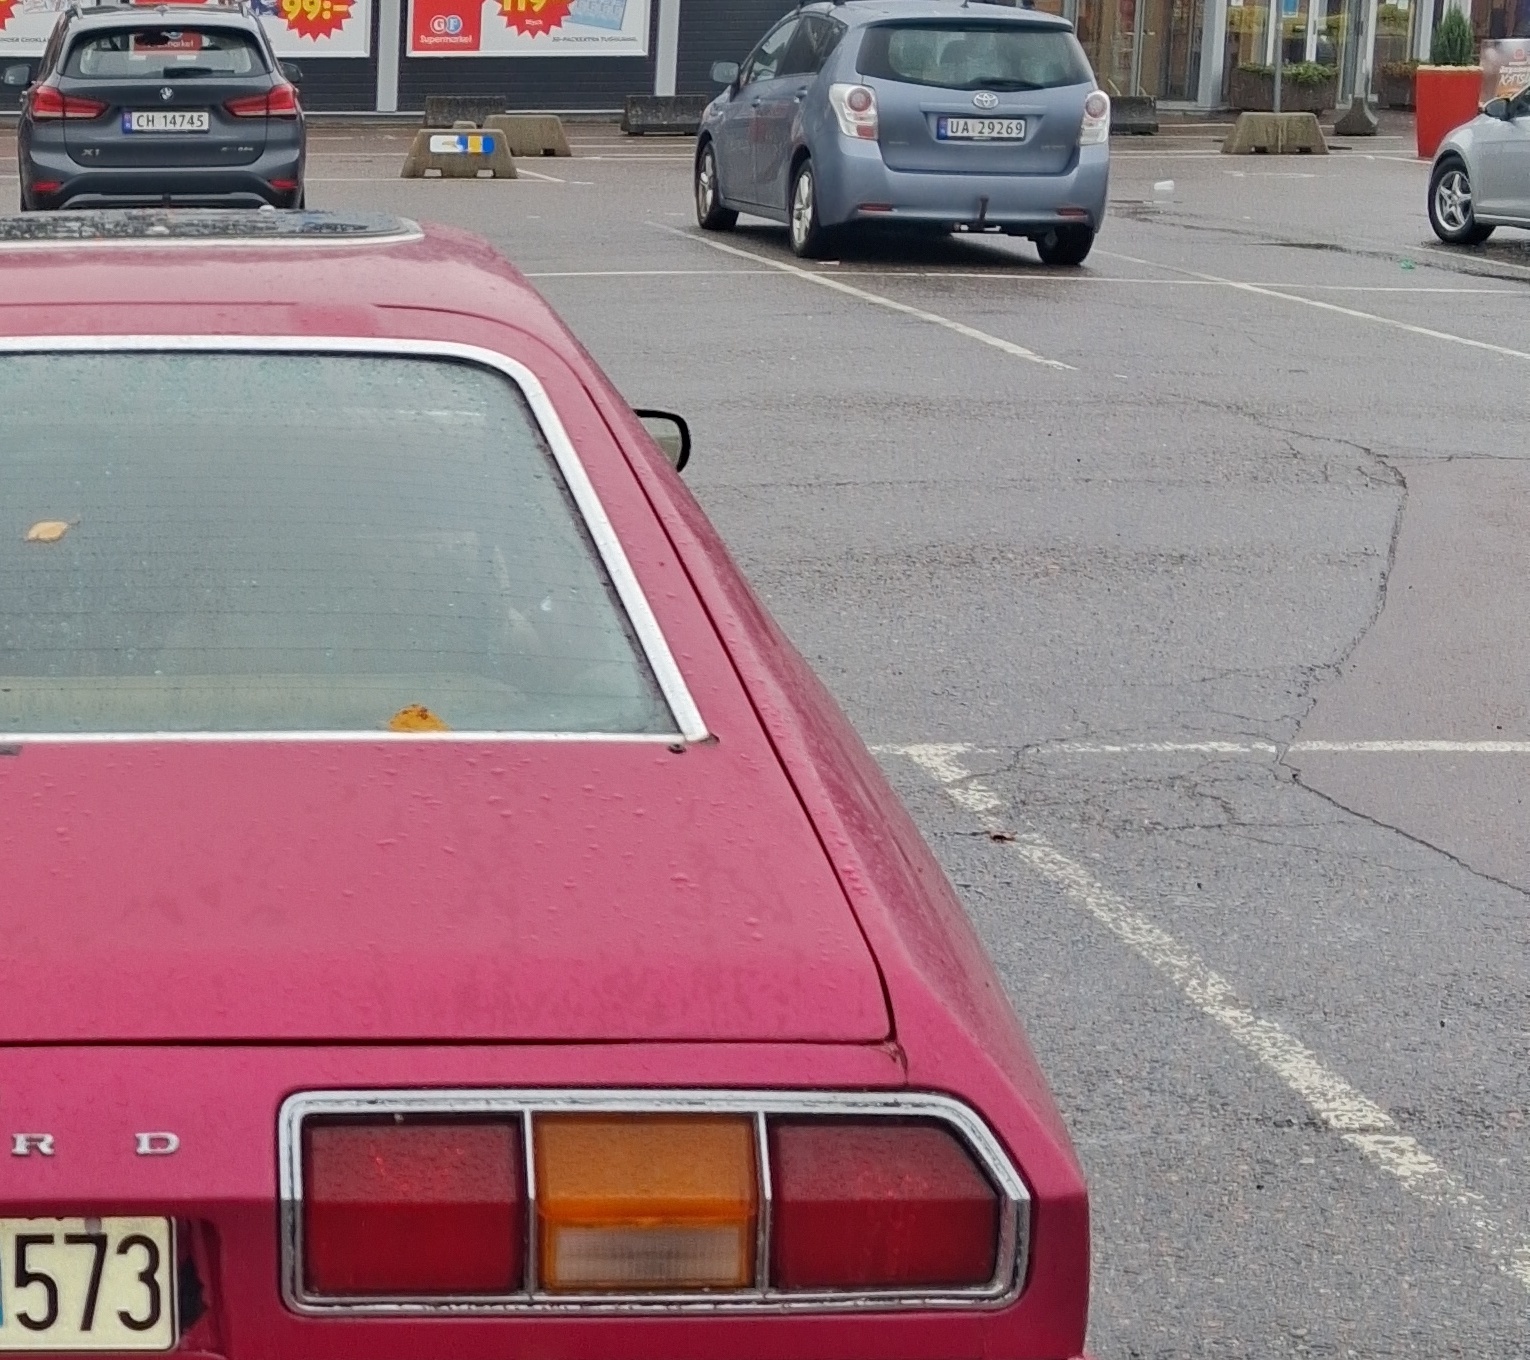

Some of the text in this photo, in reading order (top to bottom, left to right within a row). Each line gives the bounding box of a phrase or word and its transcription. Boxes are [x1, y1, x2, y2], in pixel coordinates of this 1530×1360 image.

[136, 114, 155, 128] CH
[162, 114, 204, 128] 14745
[950, 120, 969, 134] UA
[977, 121, 1023, 135] 29269
[12, 1233, 162, 1332] 573
